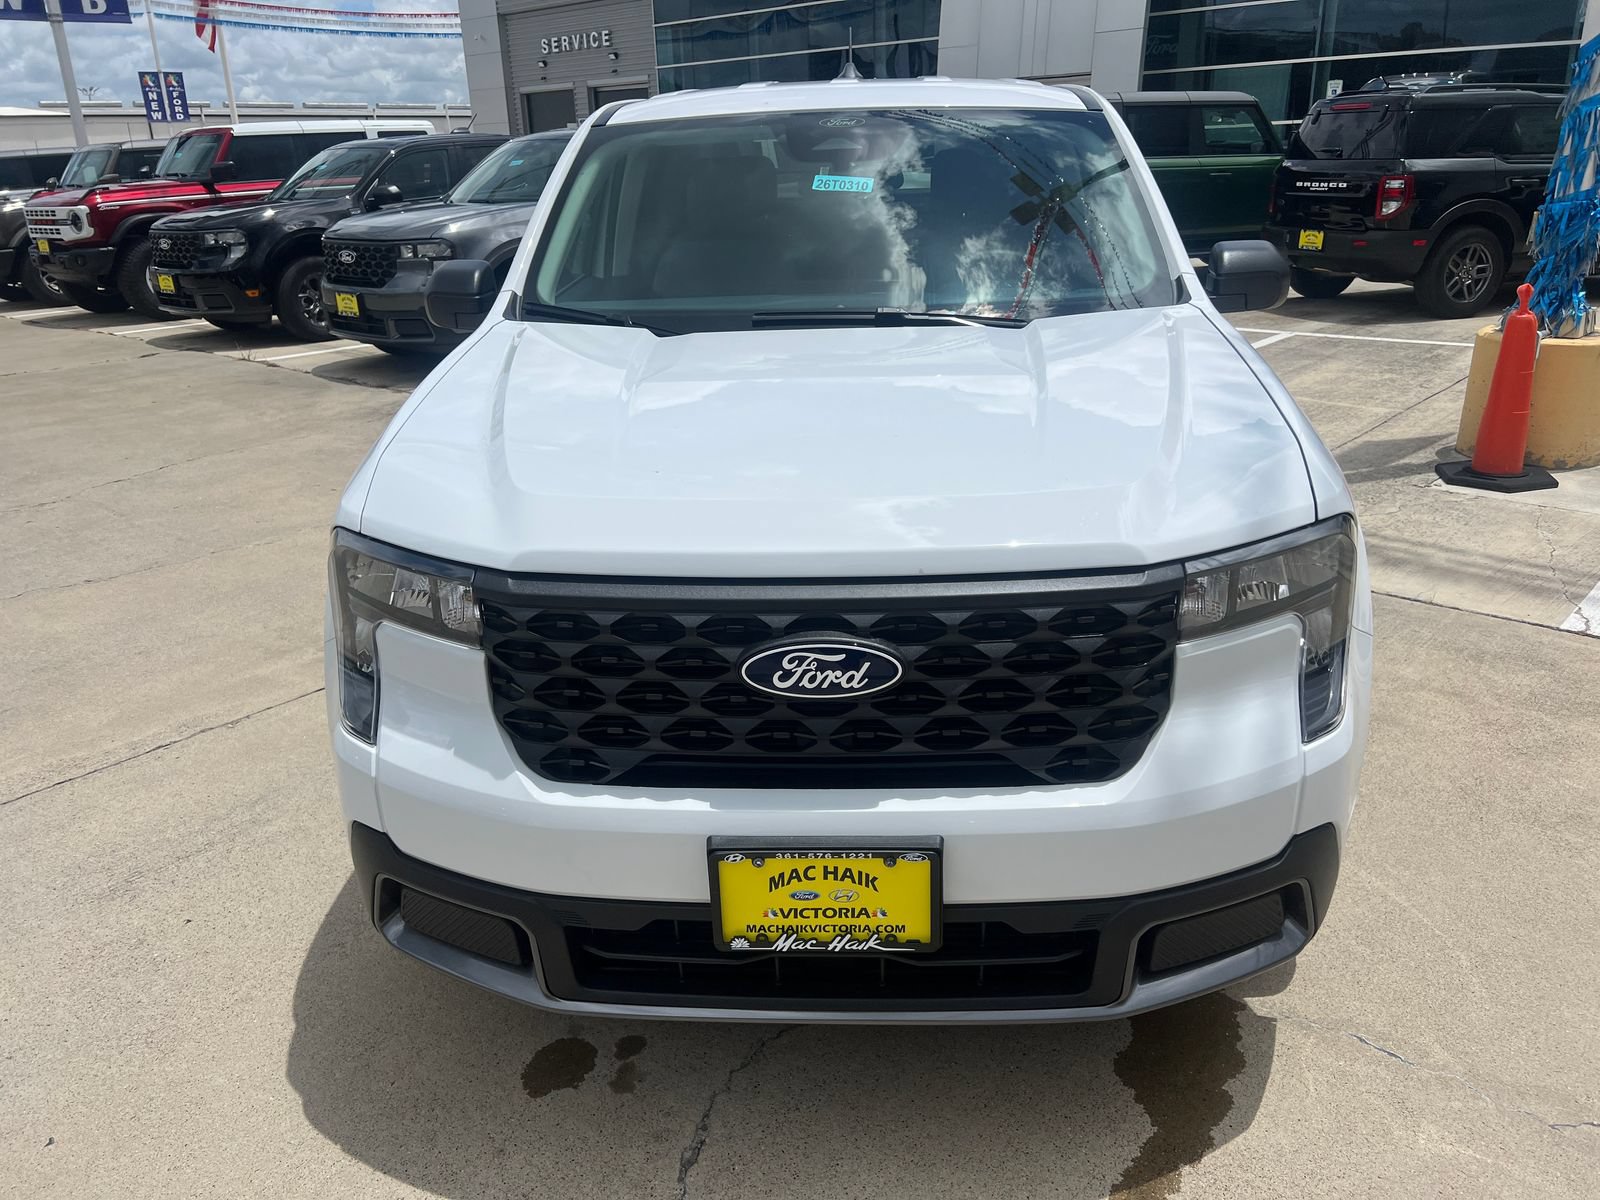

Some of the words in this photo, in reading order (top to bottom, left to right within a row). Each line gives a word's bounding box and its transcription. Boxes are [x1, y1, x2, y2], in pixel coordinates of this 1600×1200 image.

[541, 30, 610, 54] SERVICE
[148, 91, 162, 120] NEW
[172, 91, 184, 120] FORD
[815, 178, 869, 191] 26T0310
[772, 652, 871, 689] Ford
[769, 865, 816, 893] MAC
[823, 865, 879, 893] HAIK
[778, 907, 871, 919] VICTORIA
[746, 924, 906, 934] MACHAIKVICTORIA.COM
[772, 933, 825, 952] Mac
[827, 933, 884, 952] Haik
